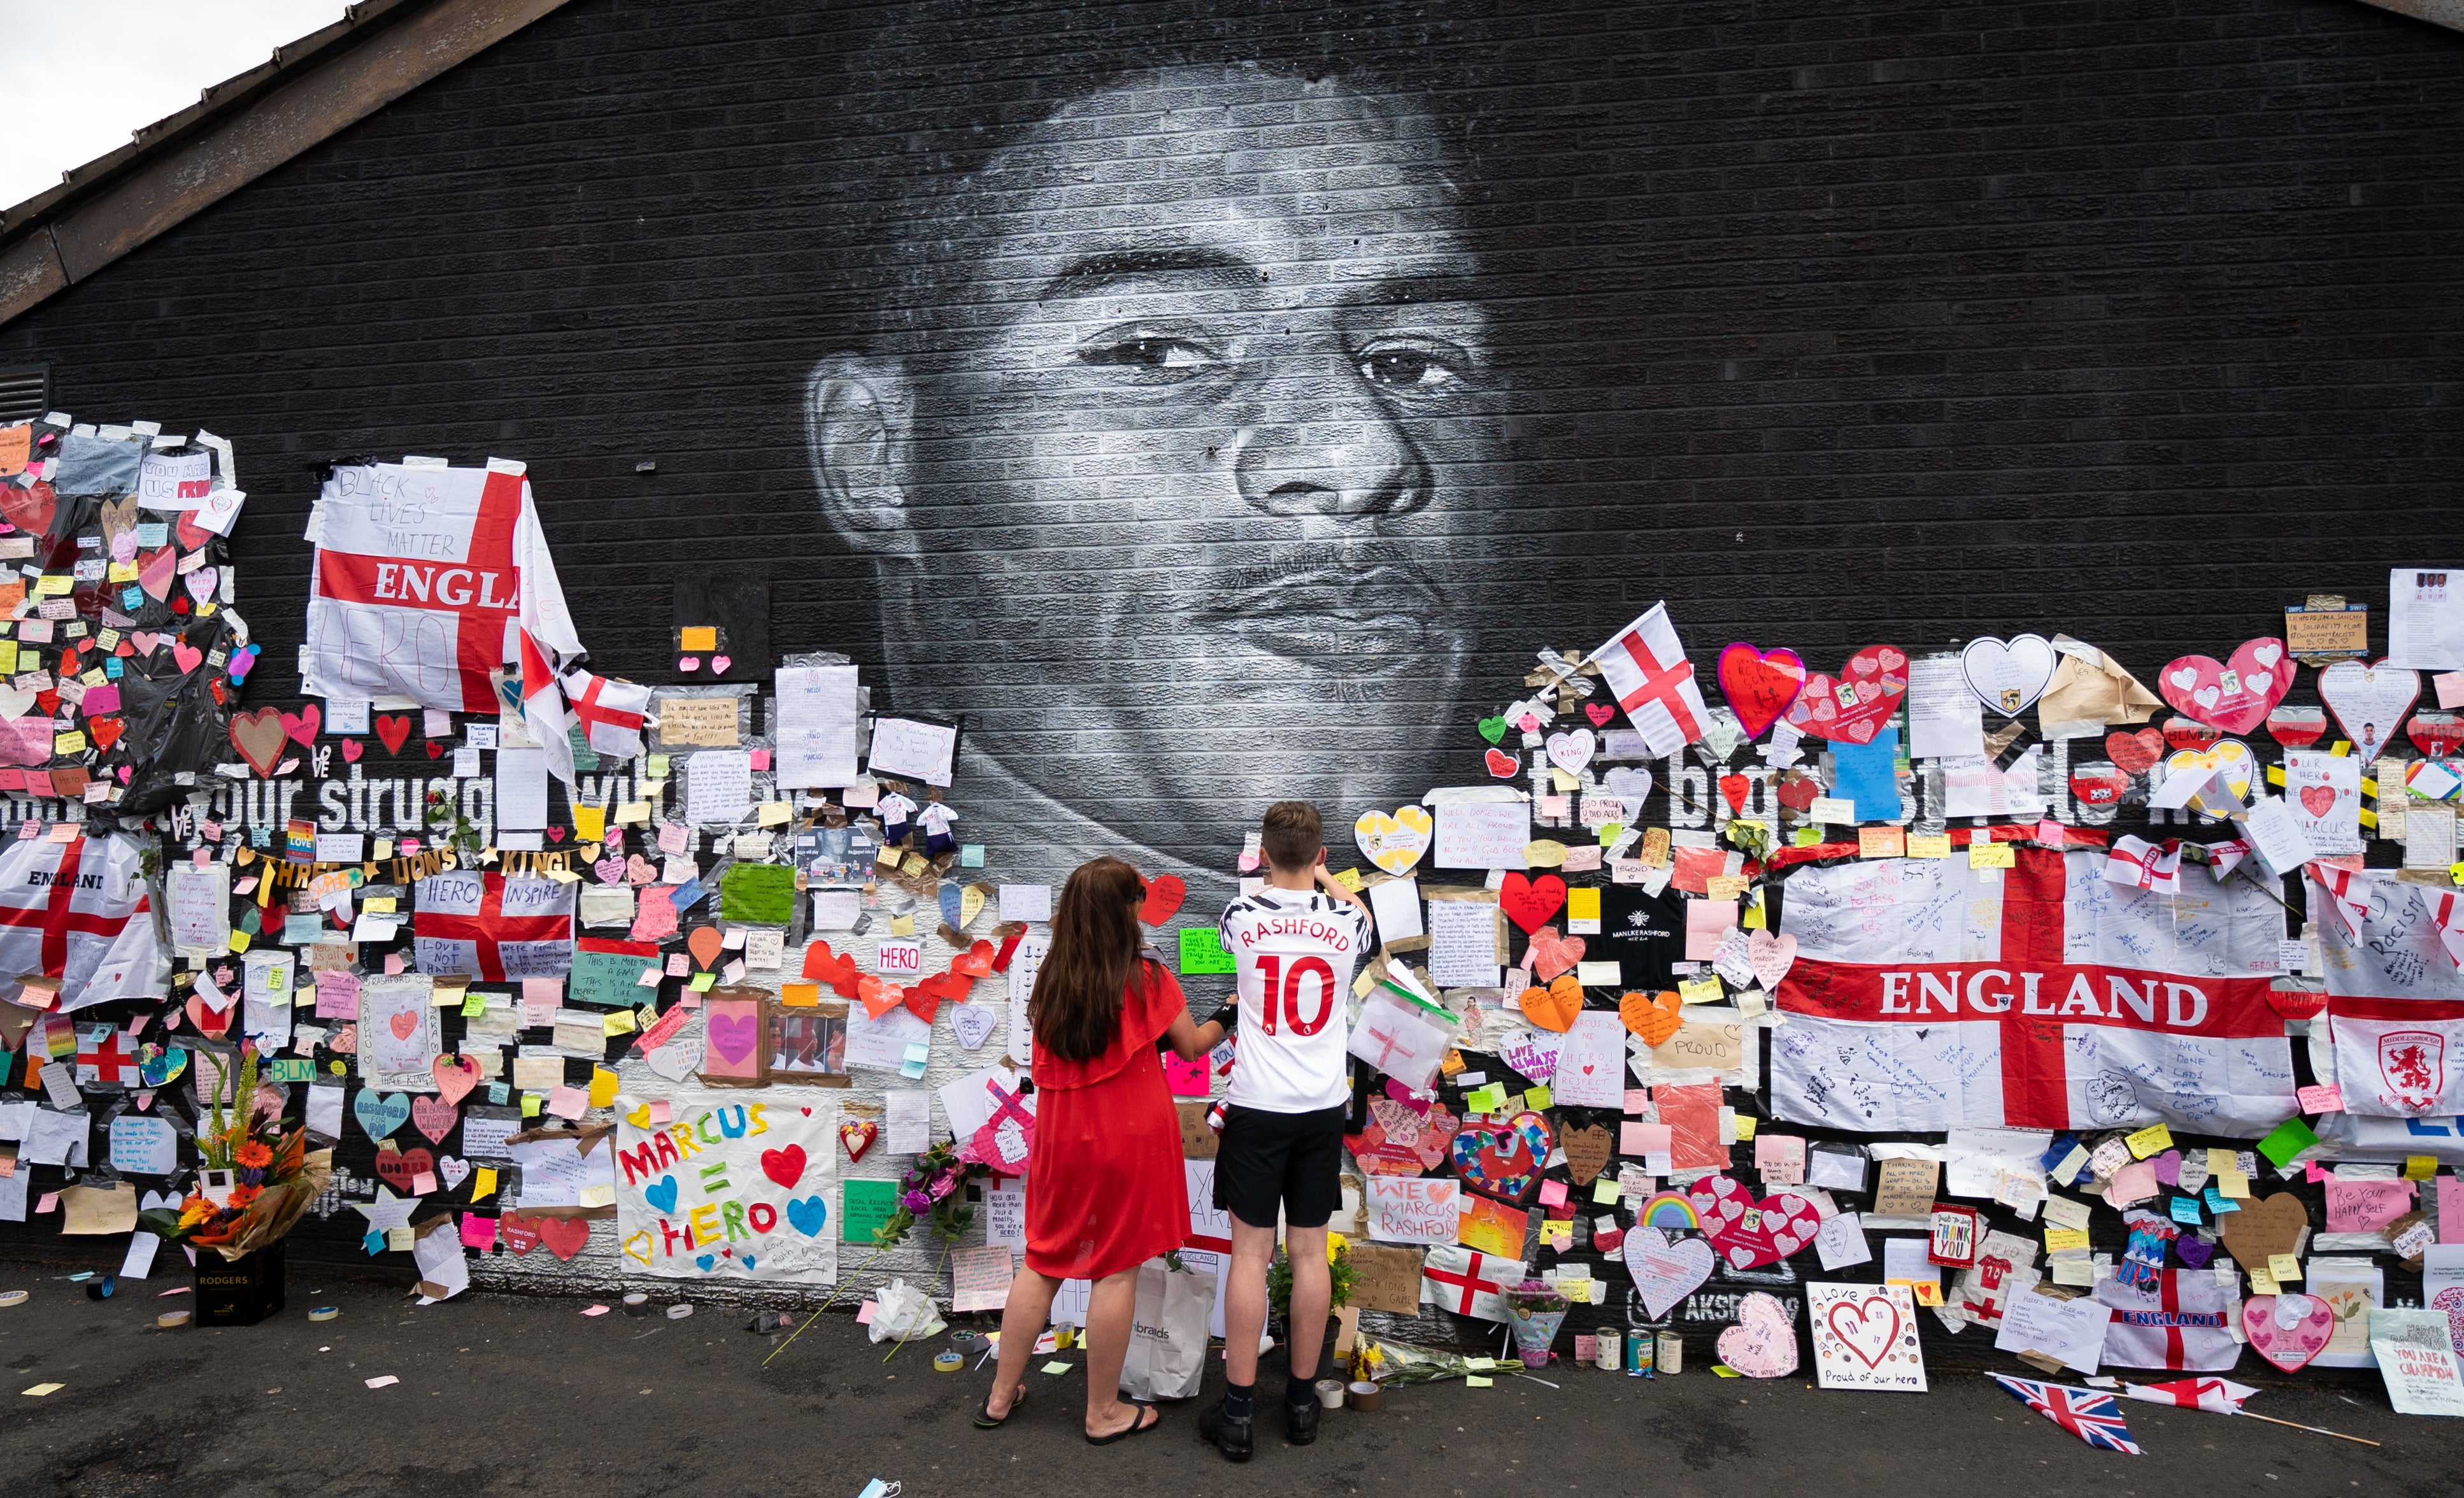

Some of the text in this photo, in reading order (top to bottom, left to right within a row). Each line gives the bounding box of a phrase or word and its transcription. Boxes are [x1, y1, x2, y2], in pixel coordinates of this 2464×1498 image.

[143, 462, 208, 478] YOU MADE
[145, 480, 211, 499] US PROU
[339, 471, 406, 497] BLACK
[370, 497, 426, 525] LIVES
[387, 532, 455, 555] MATTER
[320, 605, 450, 692] HERO
[2168, 729, 2200, 742] BLM
[2413, 727, 2463, 741] HERO
[1560, 747, 1582, 759] KING
[2286, 787, 2359, 798] WE YOU
[207, 778, 304, 834] our
[319, 763, 493, 850] strugg
[1584, 799, 1622, 809] SO PROUD
[1442, 808, 1465, 817] WELL
[1582, 810, 1602, 818] U DID
[1487, 821, 1514, 830] PROUD
[2295, 820, 2347, 833] MARCUS
[290, 837, 312, 849] LOVE
[1442, 834, 1524, 845] OF YOU SHOULD
[1456, 845, 1472, 853] TOO
[1481, 844, 1499, 855] GOD
[1502, 845, 1524, 854] BLESS
[392, 845, 457, 885] LIONS
[501, 850, 571, 880] KING!
[1616, 865, 1648, 873] LEGEND
[2069, 867, 2102, 888] LOVE
[428, 879, 562, 904] HERO INSPIRE
[2074, 890, 2112, 914] PEACE
[1906, 905, 1929, 925] KINGS
[650, 920, 669, 929] WIN
[2368, 895, 2425, 956] RACISM
[1241, 918, 1350, 952] RASHFORD
[423, 940, 461, 951] LOVE
[434, 954, 459, 965] NOT
[586, 953, 639, 967] THIS IS MORE
[880, 947, 920, 969] HERO
[2249, 960, 2272, 971] HERO
[427, 964, 466, 974] HATE
[607, 968, 614, 976] A
[372, 975, 411, 985] RASHFORD
[584, 977, 602, 987] THIS
[574, 987, 597, 996] RESPECT
[1255, 955, 1335, 1036] 10
[1879, 969, 2209, 1027] ENGLAND
[2278, 1007, 2315, 1016] MODEL!
[362, 1000, 373, 1049] SANCHO
[429, 1006, 439, 1038] SAKA
[643, 1007, 681, 1045] RASHFORD
[2383, 1034, 2440, 1045] MIDDLESBROUGH
[1211, 1048, 1235, 1065] YOU
[1507, 1044, 1534, 1060] LOVE
[1674, 1040, 1727, 1059] PROUD
[1510, 1050, 1558, 1070] ALWAYS
[1566, 1052, 1606, 1063] HERO
[2176, 1055, 2207, 1066] DONE
[273, 1060, 316, 1081] BLM
[1523, 1064, 1557, 1081] WINS
[381, 1073, 434, 1087] THREE KINGS
[1561, 1076, 1609, 1086] RESPECT
[1906, 1068, 1947, 1101] england
[357, 1101, 407, 1117] RASHFORD
[415, 1104, 451, 1114] WE LOVE
[2172, 1095, 2219, 1110] COUNTRY
[420, 1115, 455, 1129] MARCUS
[368, 1123, 385, 1138] PM
[618, 1102, 768, 1187] MARCUS
[380, 1162, 428, 1174] ADORED
[442, 1161, 460, 1170] Thank
[1370, 1178, 1423, 1200] WE
[2334, 1187, 2386, 1206] Be Your
[989, 1194, 1016, 1202] you are
[1385, 1201, 1456, 1217] MARCUS
[2334, 1204, 2363, 1219] HAPPY
[507, 1227, 536, 1239] RASHFORD
[659, 1200, 778, 1257] HERO
[1381, 1213, 1458, 1241] RASHFORD
[1937, 1223, 1971, 1244] THANK
[764, 1239, 785, 1252] Love
[2396, 1229, 2429, 1251] LEGEND
[1939, 1239, 1964, 1258] YOU
[1984, 1243, 2019, 1258] HERO
[771, 1248, 794, 1266] Ruth
[1179, 1253, 1215, 1262] ENGLAND
[795, 1253, 827, 1278] Blake
[200, 1276, 248, 1285] RODGERS
[1384, 1281, 1407, 1292] LONG
[1389, 1293, 1412, 1305] GAME
[1820, 1288, 1858, 1303] Love
[2059, 1304, 2076, 1315] NEVER
[2122, 1311, 2222, 1328] ENGLAND
[1132, 1320, 1170, 1339] nbraids
[2406, 1324, 2445, 1338] MARCUS
[2389, 1334, 2447, 1351] RASHFORD
[2394, 1349, 2440, 1365] YOU ARE
[1825, 1370, 1918, 1386] Proud of our hero
[2398, 1363, 2455, 1381] CHAMPION
